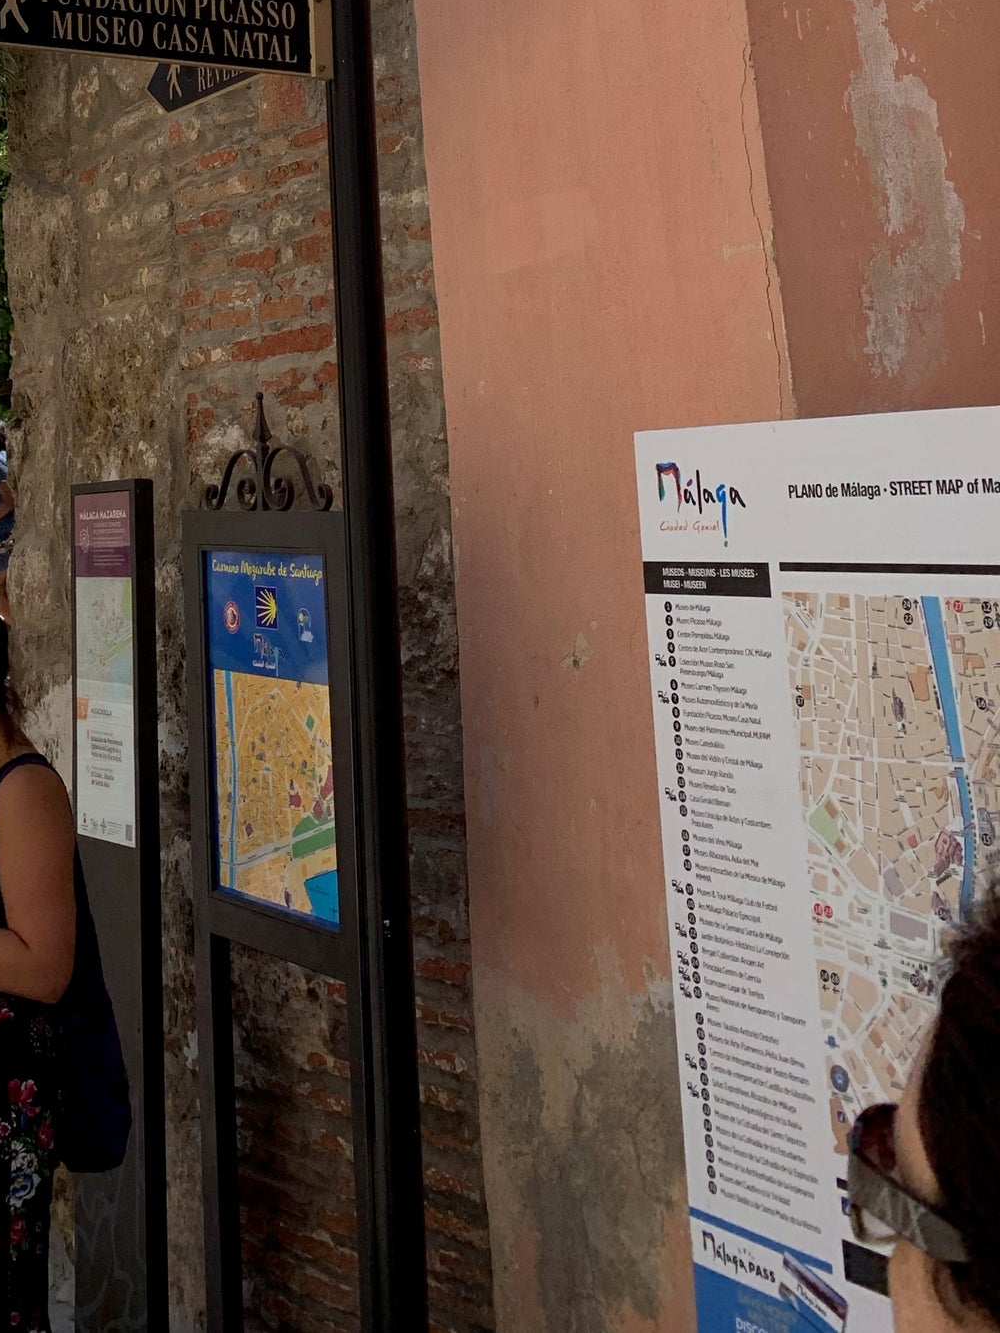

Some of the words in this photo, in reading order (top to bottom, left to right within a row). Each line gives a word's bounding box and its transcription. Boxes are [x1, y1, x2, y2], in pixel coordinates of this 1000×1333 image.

[52, 10, 144, 47] MUSEO
[152, 21, 216, 55] CASA
[223, 27, 298, 63] NATAL
[788, 483, 823, 498] PLANO
[825, 483, 839, 498] de
[840, 482, 881, 500] Málaga
[889, 480, 933, 496] STREET
[936, 479, 964, 495] MAP
[967, 478, 979, 494] of
[655, 462, 746, 542] Málaga
[660, 520, 688, 531] Ciudad
[693, 520, 720, 533] Genial
[212, 560, 239, 574] Camino
[278, 562, 288, 577] de
[290, 564, 323, 586] Santiago
[662, 568, 686, 577] MUSEOS
[720, 568, 731, 578] LES
[748, 1261, 776, 1283] PASS
